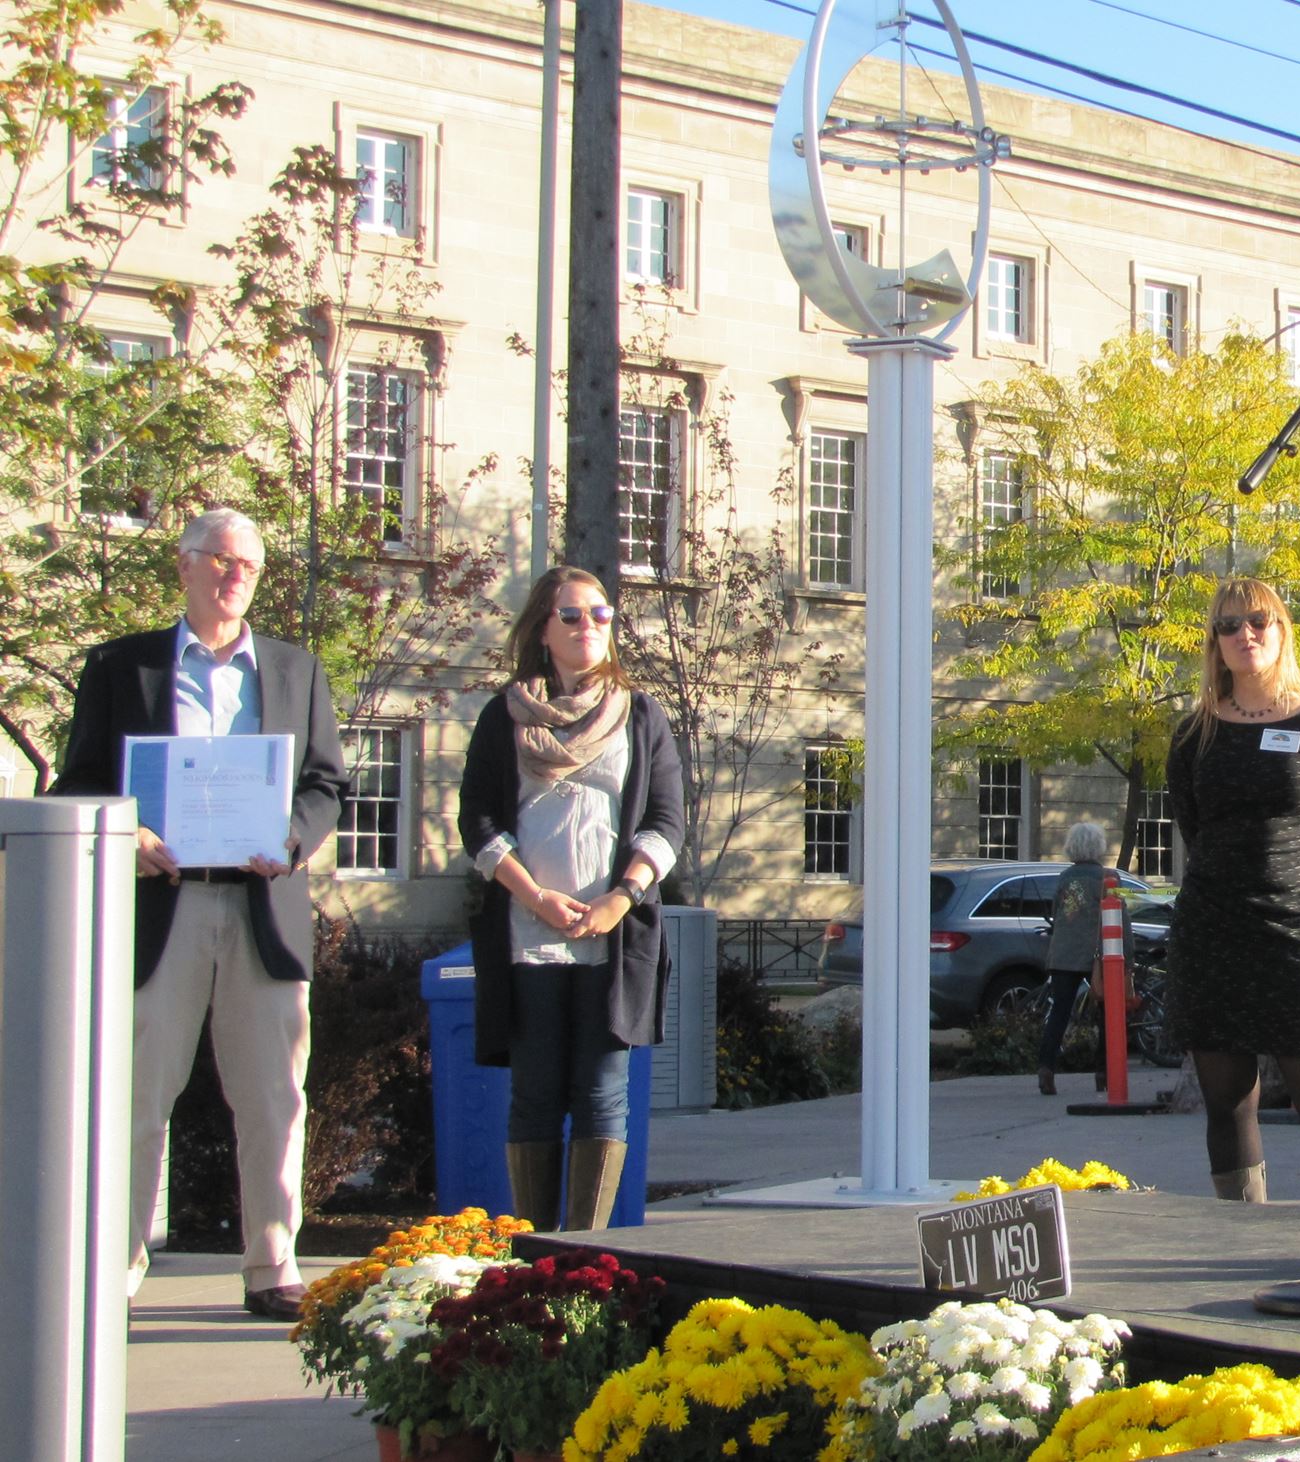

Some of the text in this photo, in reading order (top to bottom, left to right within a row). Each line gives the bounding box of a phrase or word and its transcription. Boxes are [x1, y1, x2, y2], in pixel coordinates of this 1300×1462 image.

[951, 1197, 1025, 1232] MONTANA
[948, 1222, 1040, 1289] LV MSO
[1008, 1277, 1037, 1301] 406
